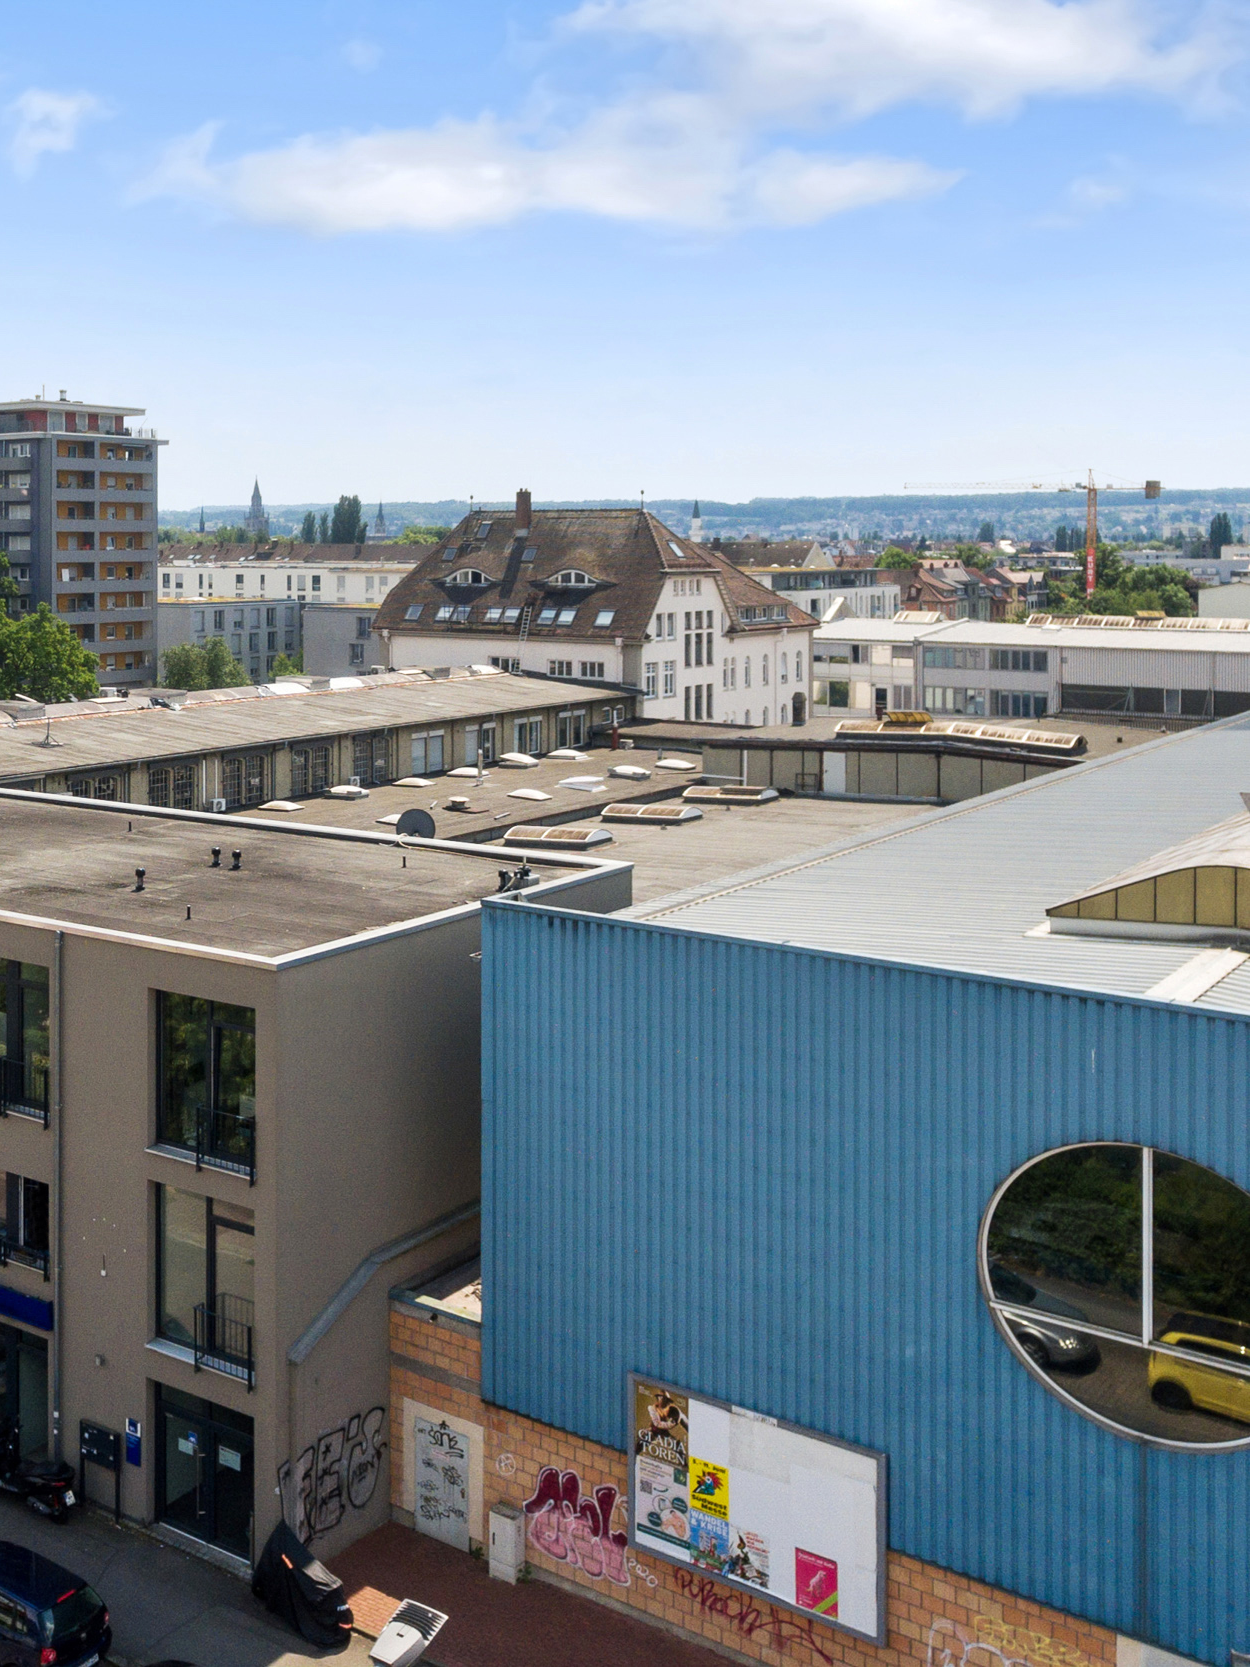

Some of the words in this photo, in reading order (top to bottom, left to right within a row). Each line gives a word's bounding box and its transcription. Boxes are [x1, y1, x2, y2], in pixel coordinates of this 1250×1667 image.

[638, 1429, 686, 1454] GLADIA
[640, 1440, 686, 1465] TOREN
[690, 1509, 727, 1527] WANDEL
[701, 1503, 727, 1516] Messe
[700, 1521, 728, 1536] KRISE
